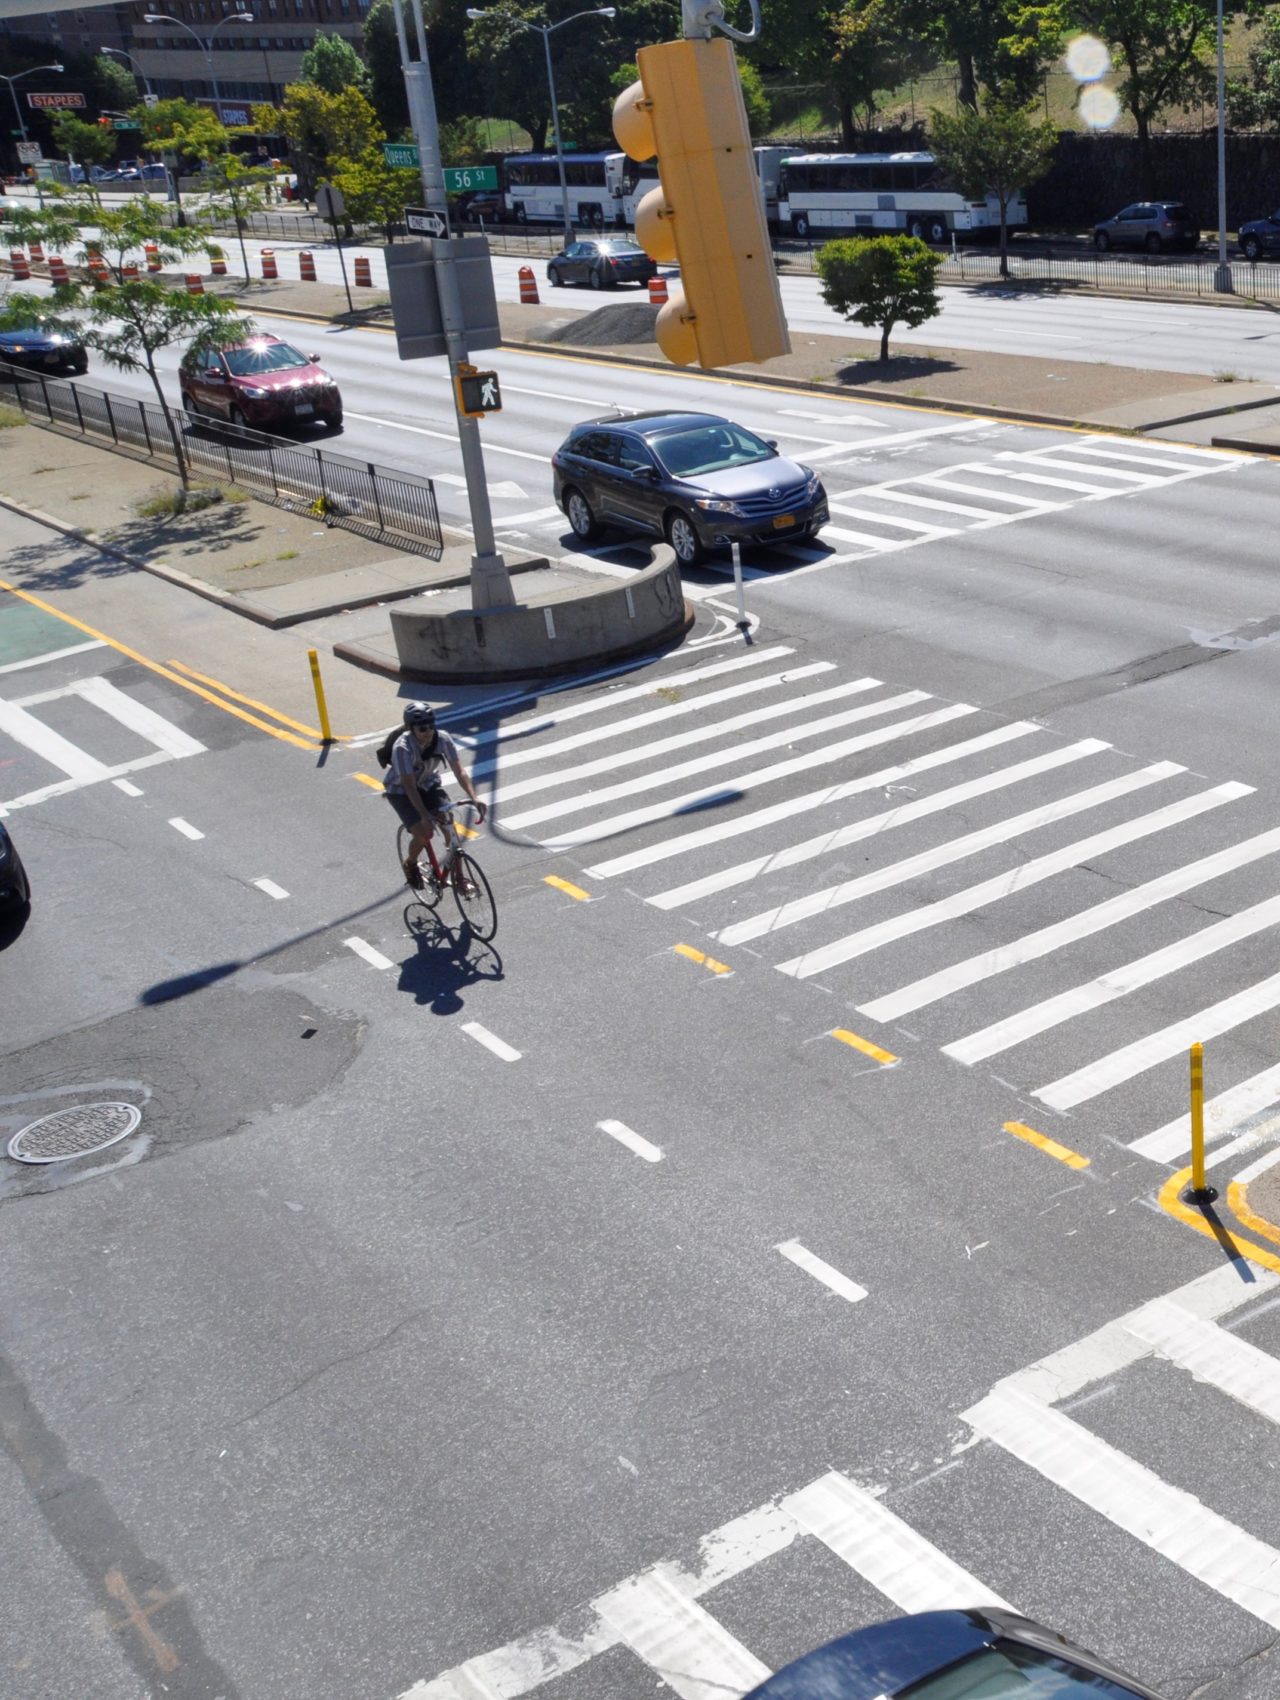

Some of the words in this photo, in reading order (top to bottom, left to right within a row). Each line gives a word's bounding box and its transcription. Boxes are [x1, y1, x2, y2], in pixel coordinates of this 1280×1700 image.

[32, 96, 82, 107] STAPLES
[384, 146, 413, 165] Queens
[455, 171, 471, 188] 56
[476, 170, 485, 181] St
[411, 217, 425, 229] ONE
[429, 219, 441, 231] WAY
